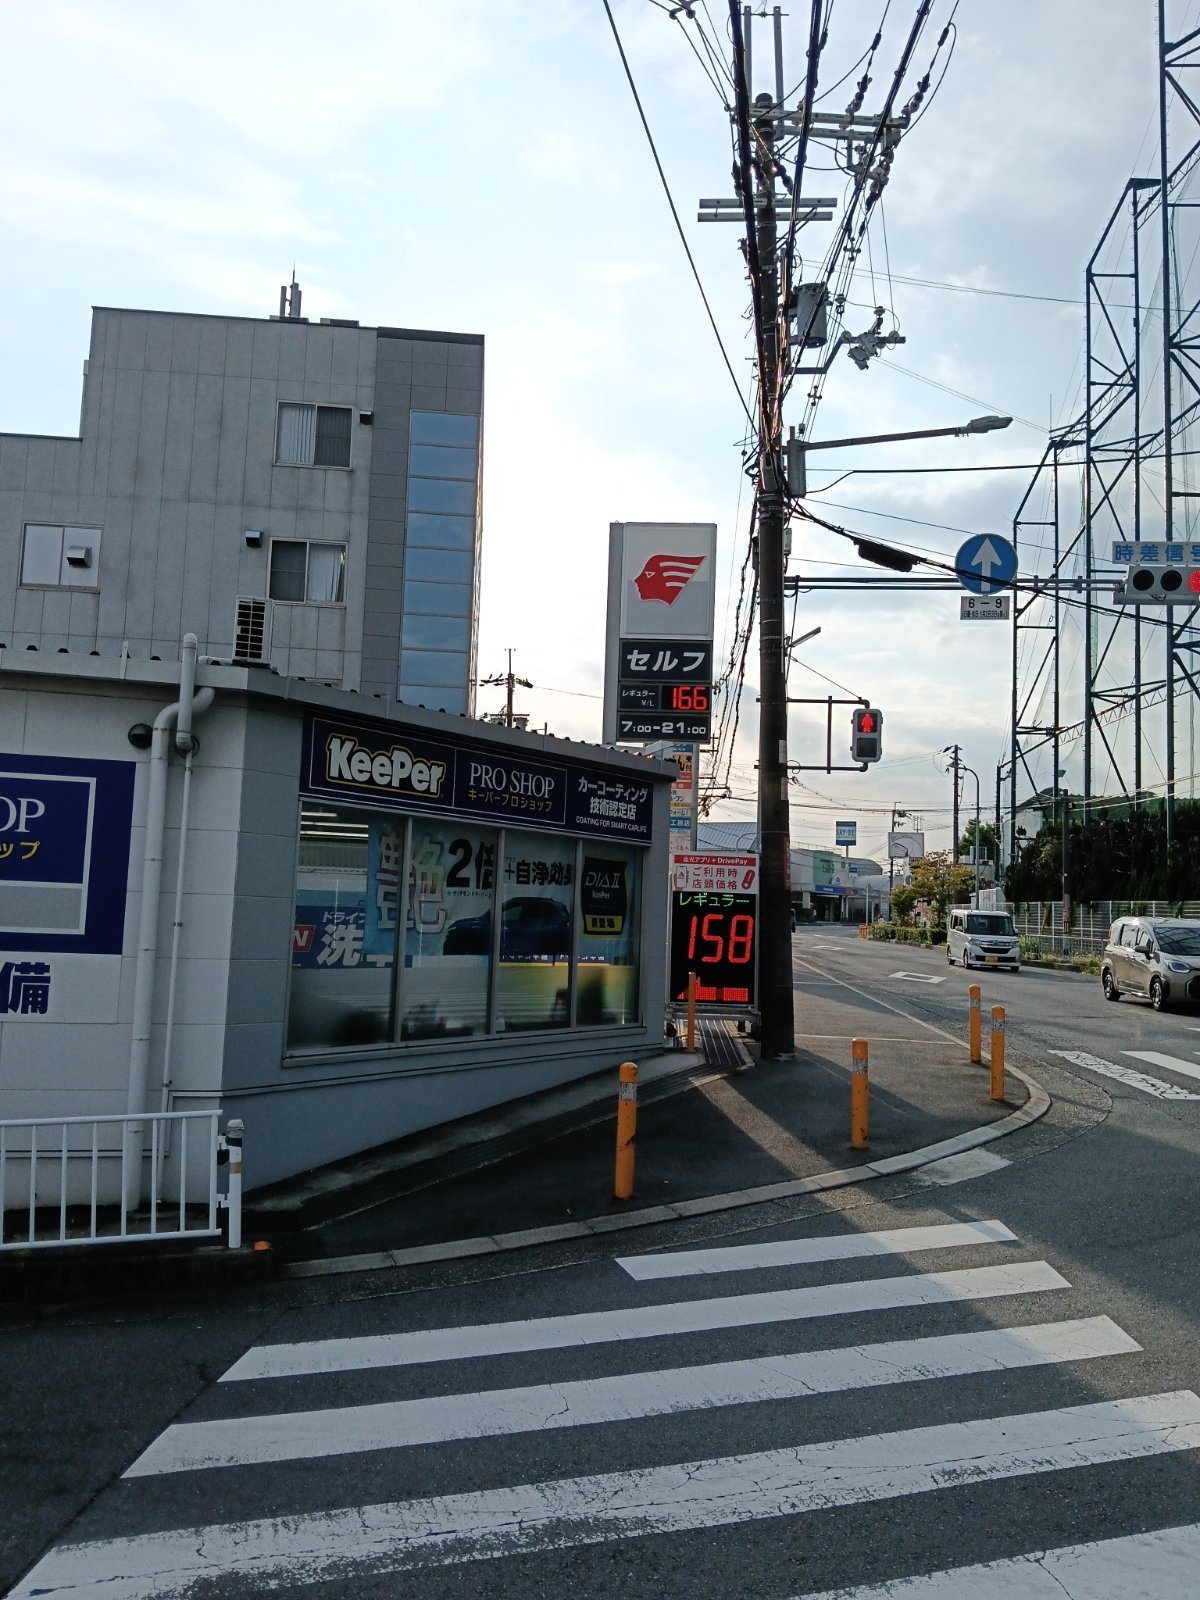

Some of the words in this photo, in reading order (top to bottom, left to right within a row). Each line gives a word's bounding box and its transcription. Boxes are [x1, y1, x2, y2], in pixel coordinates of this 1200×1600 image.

[627, 650, 706, 672] セルフ
[622, 690, 656, 698] レギュラー
[673, 687, 707, 710] 166
[622, 720, 706, 734] 7:00-21:00
[328, 736, 445, 795] KeePer
[468, 762, 507, 791] PRO
[509, 770, 555, 799] SHOP
[577, 775, 649, 803] カーコーティング
[589, 796, 637, 820] 技術認定店
[575, 815, 600, 826] COATING
[599, 819, 611, 828] FOR
[610, 821, 627, 830] SMART
[627, 823, 647, 833] CARLIFE
[717, 857, 748, 866] DrivePay
[692, 866, 739, 878] ご利用時
[692, 878, 738, 890] 店頭価格
[680, 892, 750, 907] レギュラー
[688, 914, 754, 964] 158
